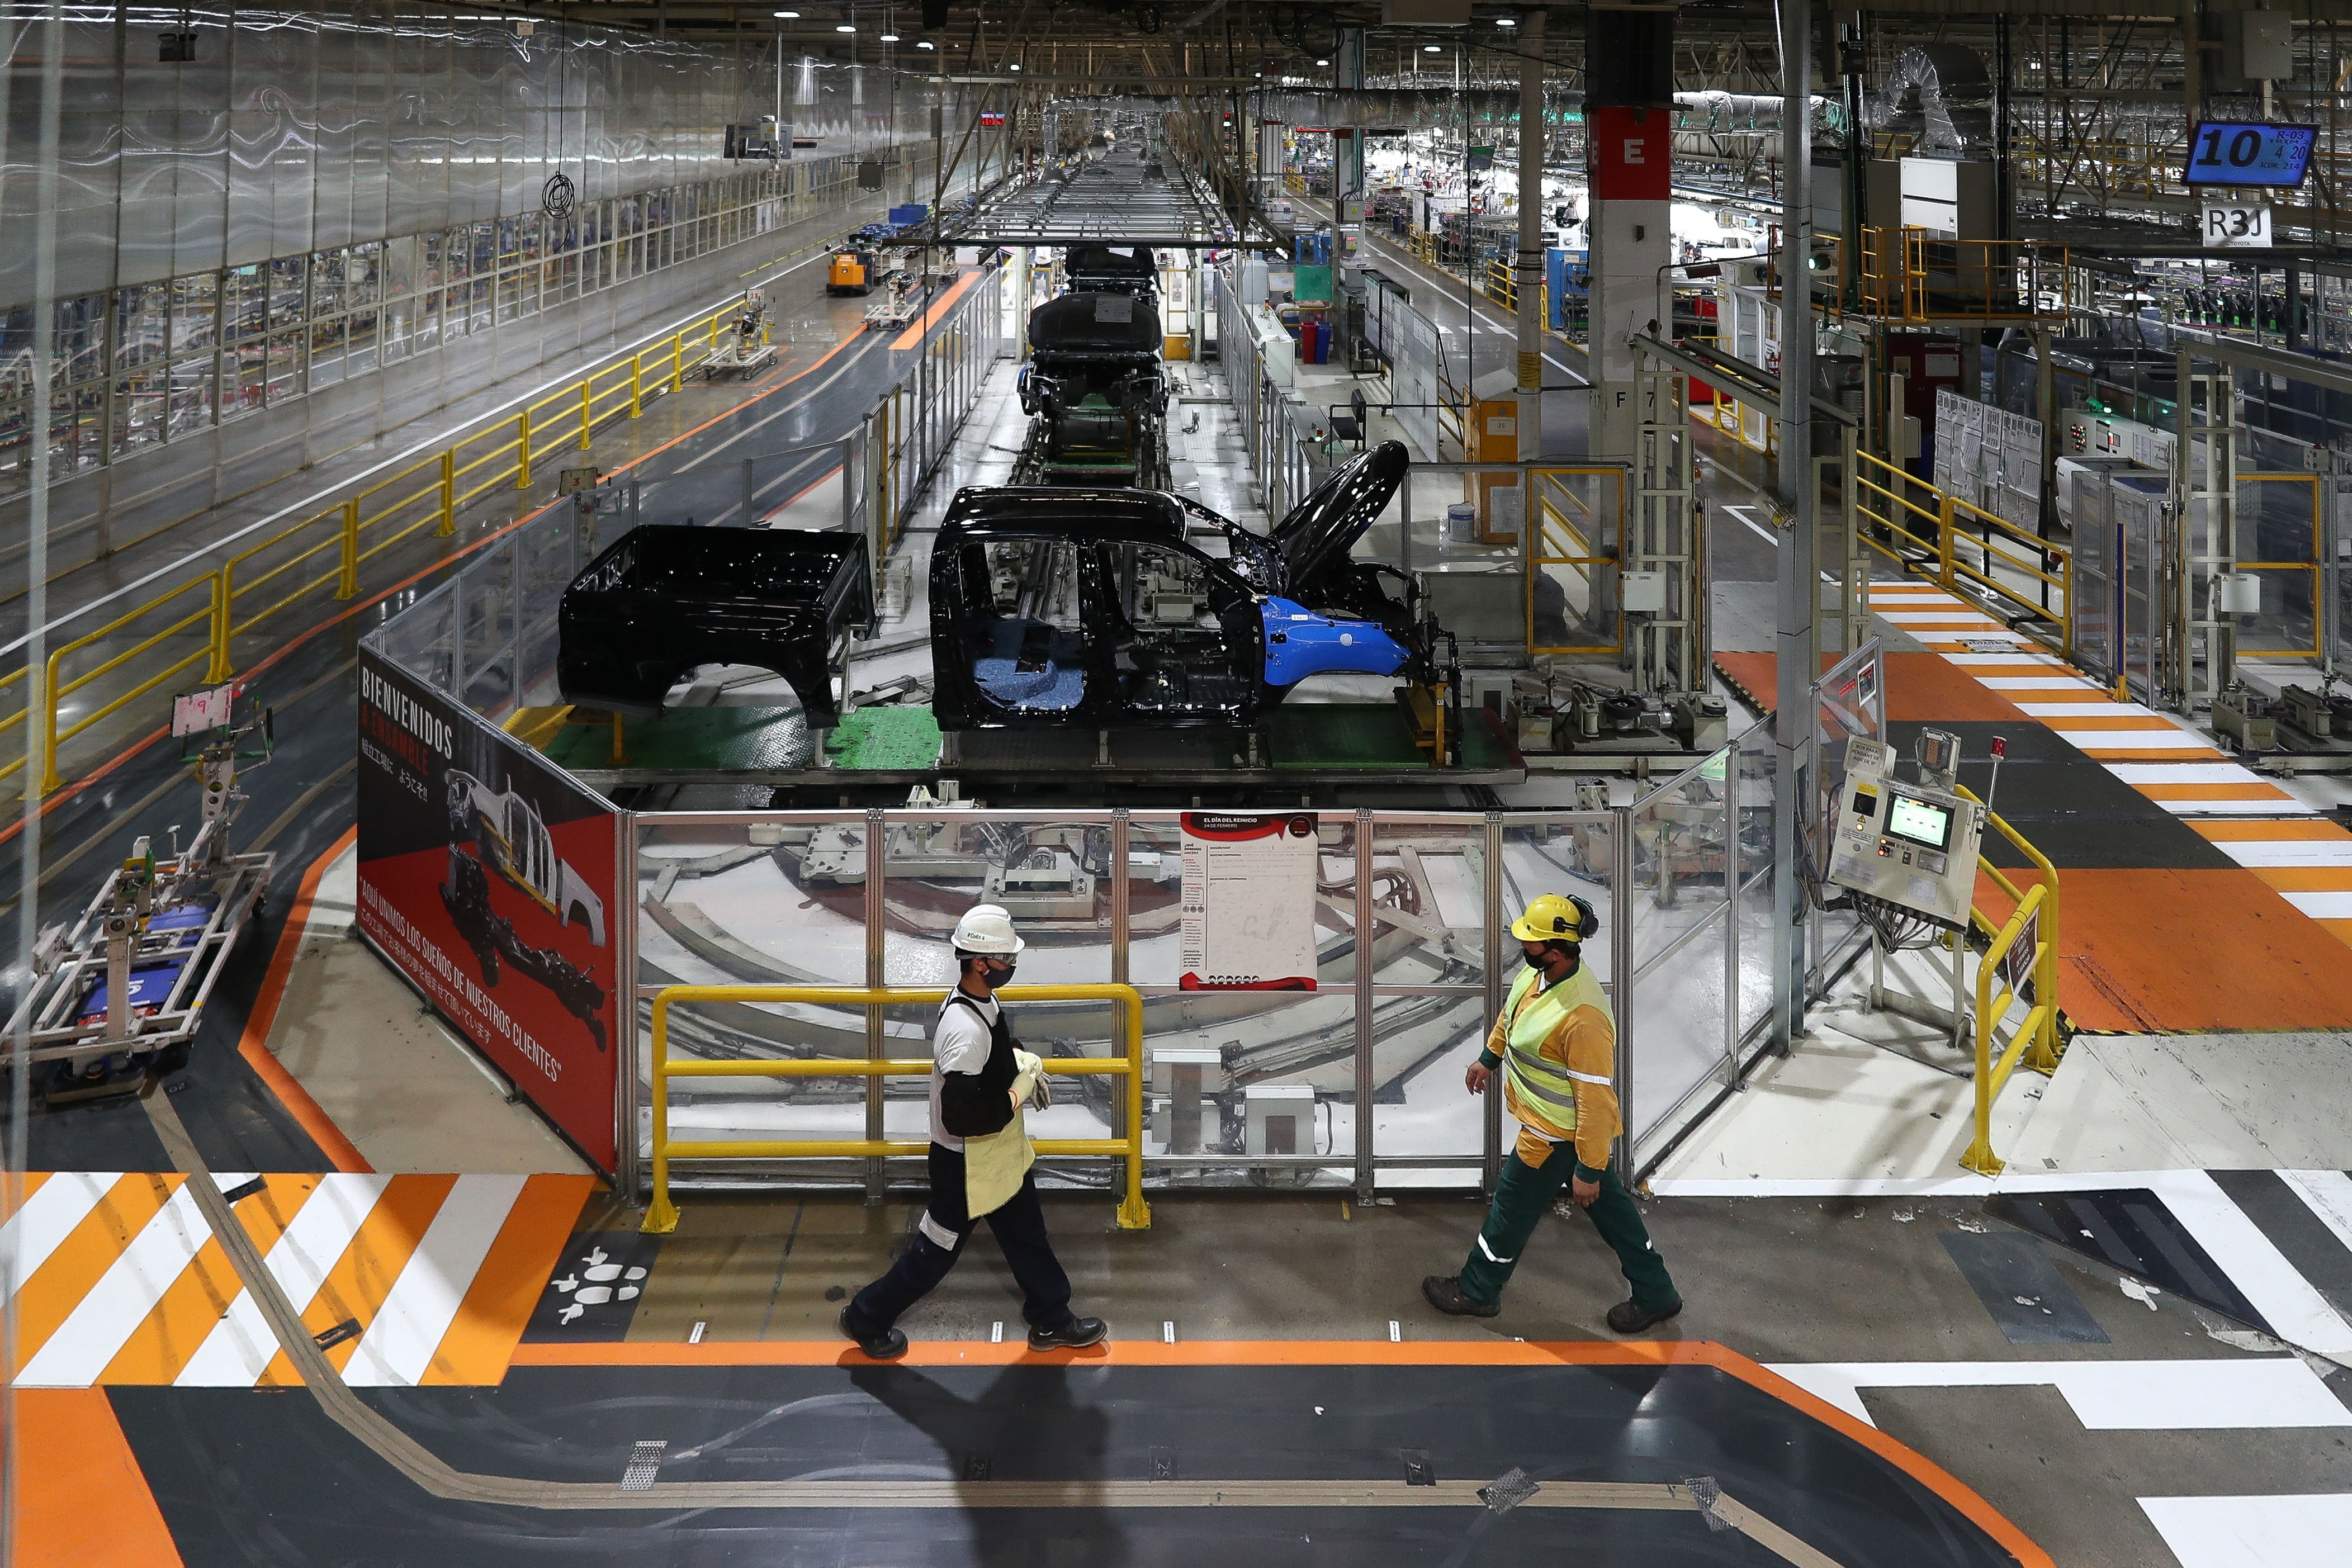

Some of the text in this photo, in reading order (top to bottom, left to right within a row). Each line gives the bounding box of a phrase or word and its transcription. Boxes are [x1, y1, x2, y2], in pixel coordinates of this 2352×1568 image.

[2195, 128, 2261, 168] 10
[2277, 130, 2304, 139] R-03
[1624, 139, 1644, 163] E
[2275, 145, 2306, 159] 4 20
[2209, 209, 2261, 237] R3J
[1616, 392, 1654, 408] F 7
[363, 666, 452, 760] BIENVENIDOS
[362, 703, 429, 776] A ENSAMBLE
[378, 894, 405, 937] UNIMOS
[407, 922, 420, 952] LOS
[422, 937, 452, 982] SUEÑOS
[454, 966, 464, 995] DE
[466, 978, 510, 1038] NUESTROS
[513, 1022, 562, 1082] CLIENTES"
